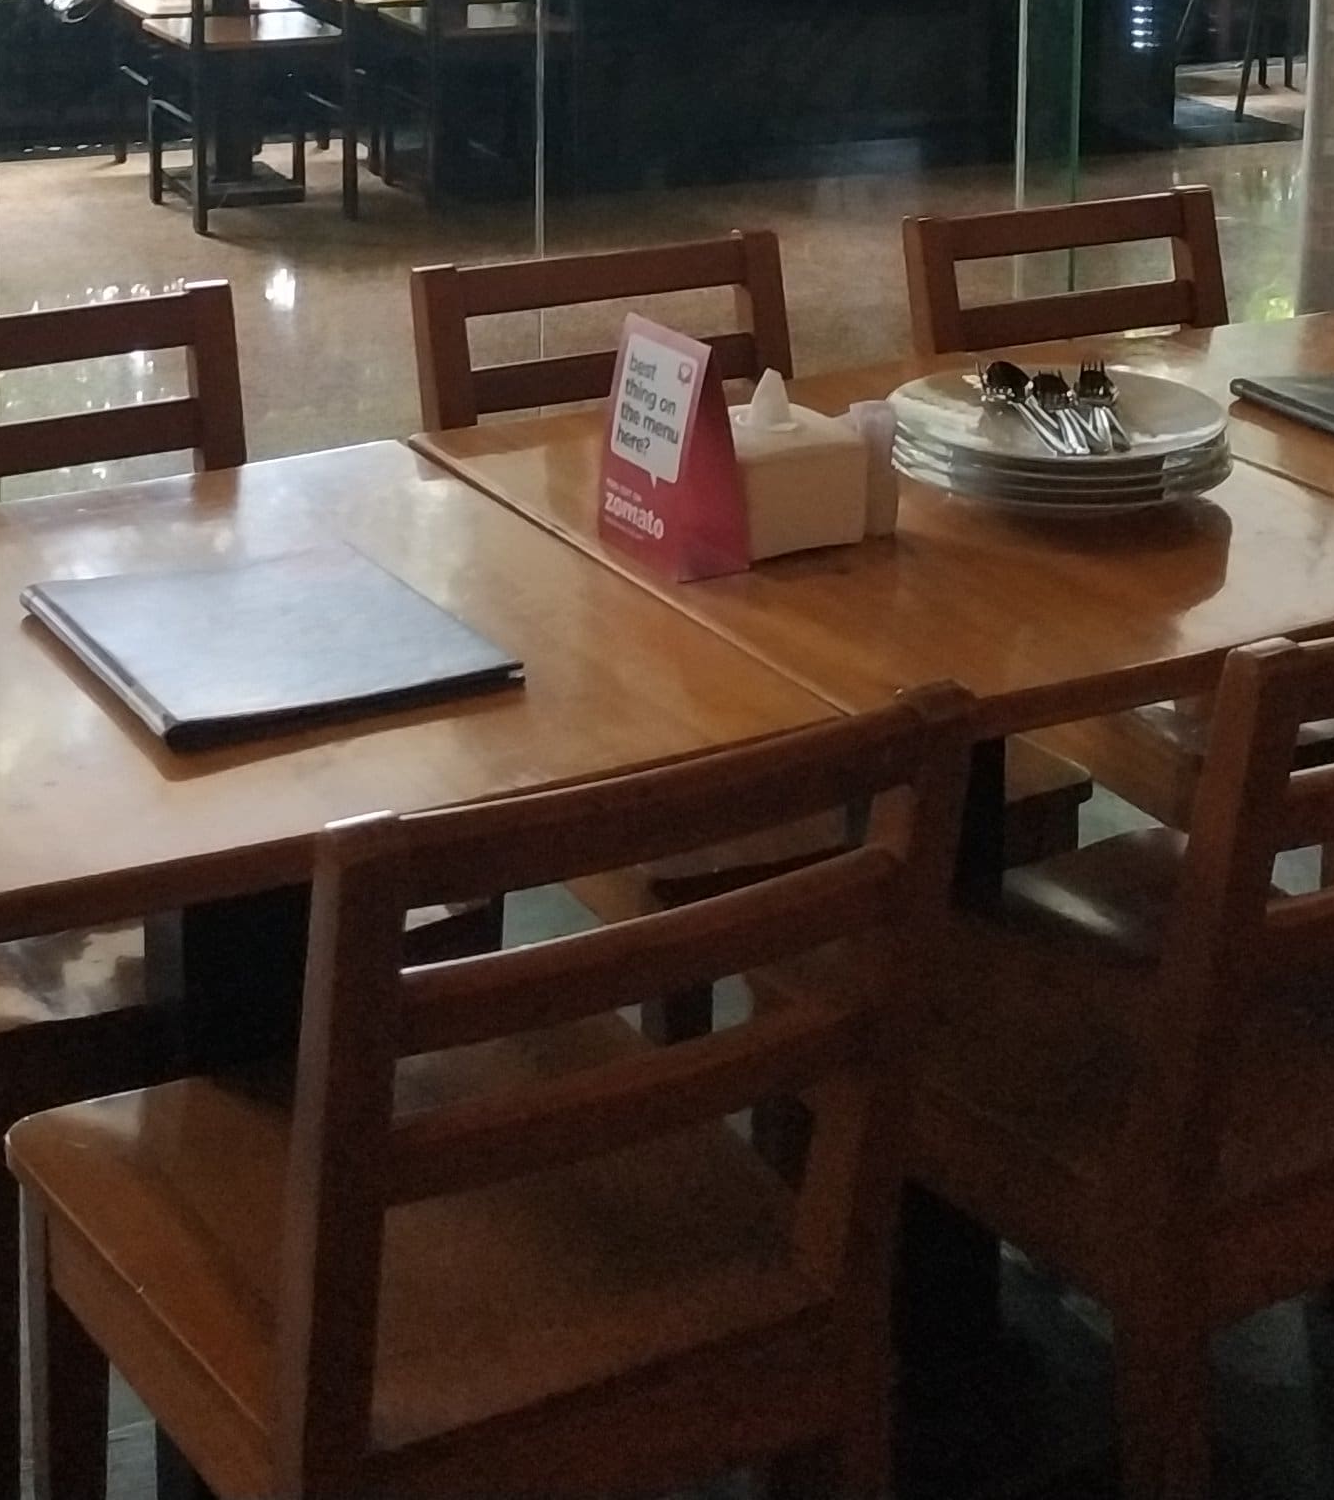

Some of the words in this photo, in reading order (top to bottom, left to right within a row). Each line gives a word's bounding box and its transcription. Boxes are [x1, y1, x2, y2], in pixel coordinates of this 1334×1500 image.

[628, 352, 657, 381] best
[624, 378, 657, 411] thing
[659, 398, 677, 415] on
[616, 424, 651, 455] here?
[620, 402, 641, 426] the
[643, 416, 679, 445] menu
[604, 491, 664, 540] zomato
